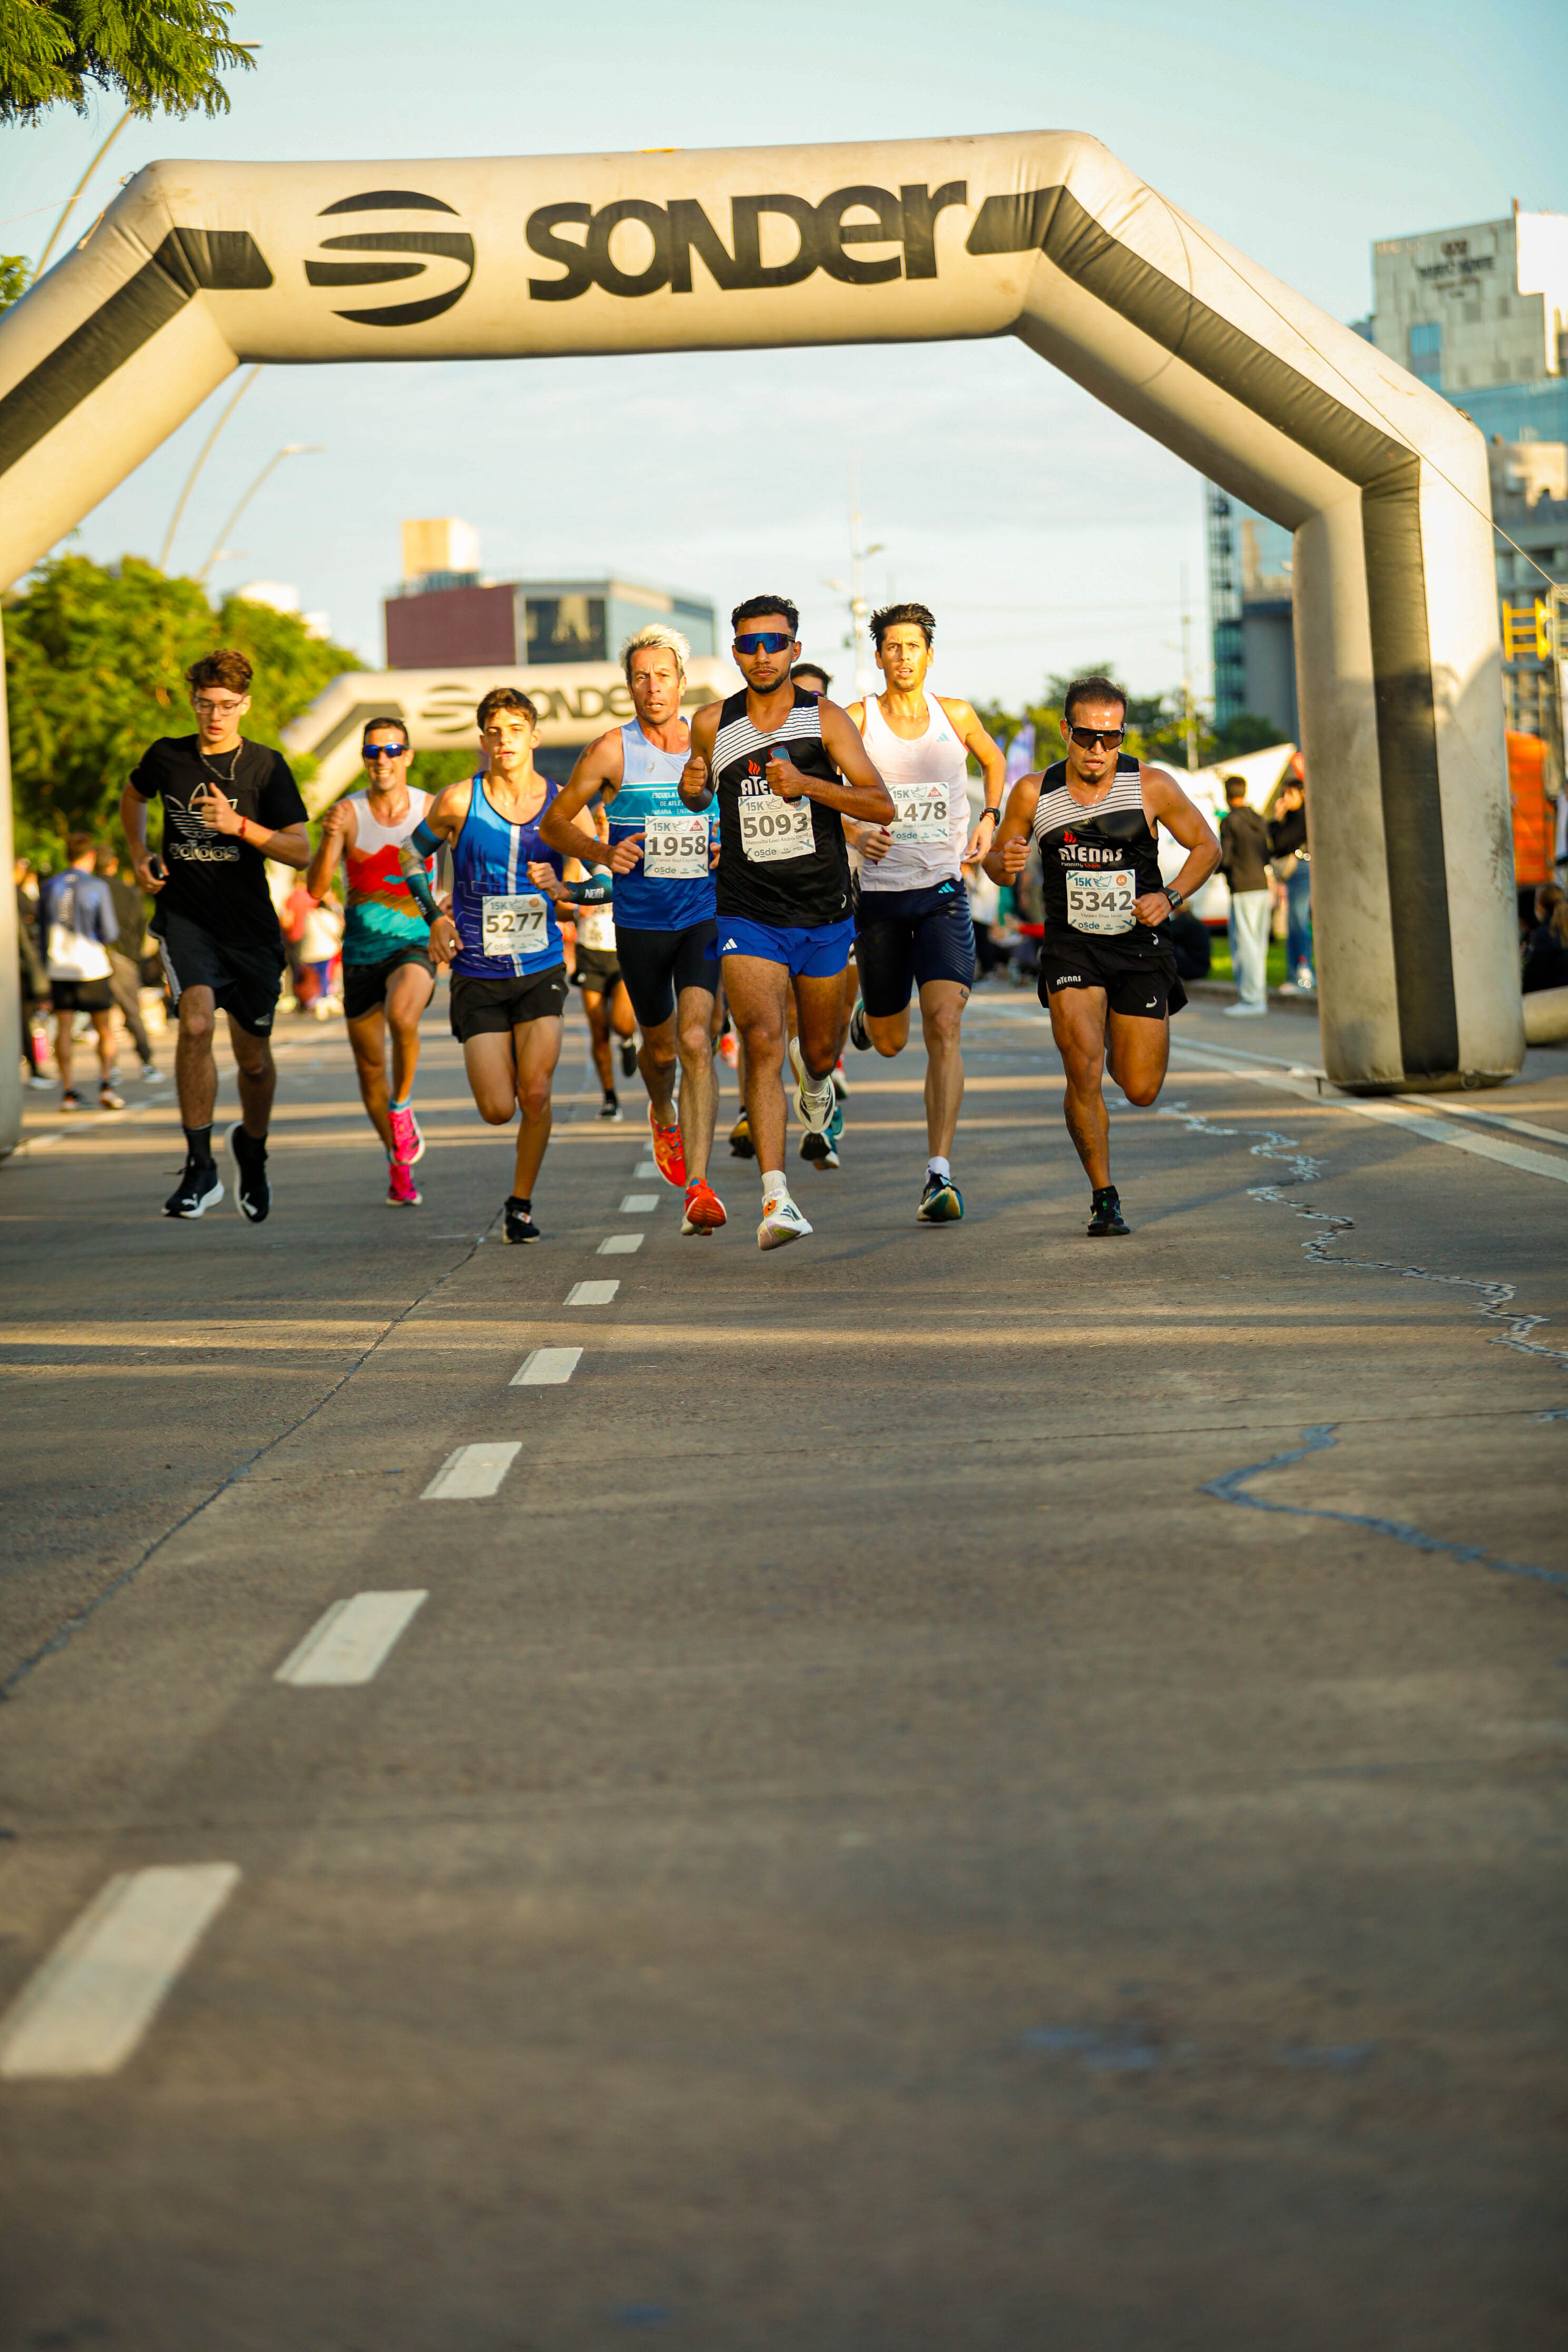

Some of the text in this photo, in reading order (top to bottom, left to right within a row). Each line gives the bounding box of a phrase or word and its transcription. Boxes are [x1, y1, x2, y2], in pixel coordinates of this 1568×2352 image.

[741, 776, 772, 795] ATE
[893, 790, 909, 798] 15K
[746, 801, 764, 811] 15K
[891, 801, 946, 821] 1478
[653, 823, 671, 831] 15K
[743, 812, 808, 838] 5093
[169, 839, 240, 861] adidas
[649, 836, 706, 856] 1958
[754, 848, 777, 857] osde
[1058, 844, 1122, 863] ATENAS
[1074, 877, 1092, 887] 15K
[1070, 890, 1133, 912] 5342
[486, 912, 543, 933] 5277
[1079, 922, 1100, 930] osde
